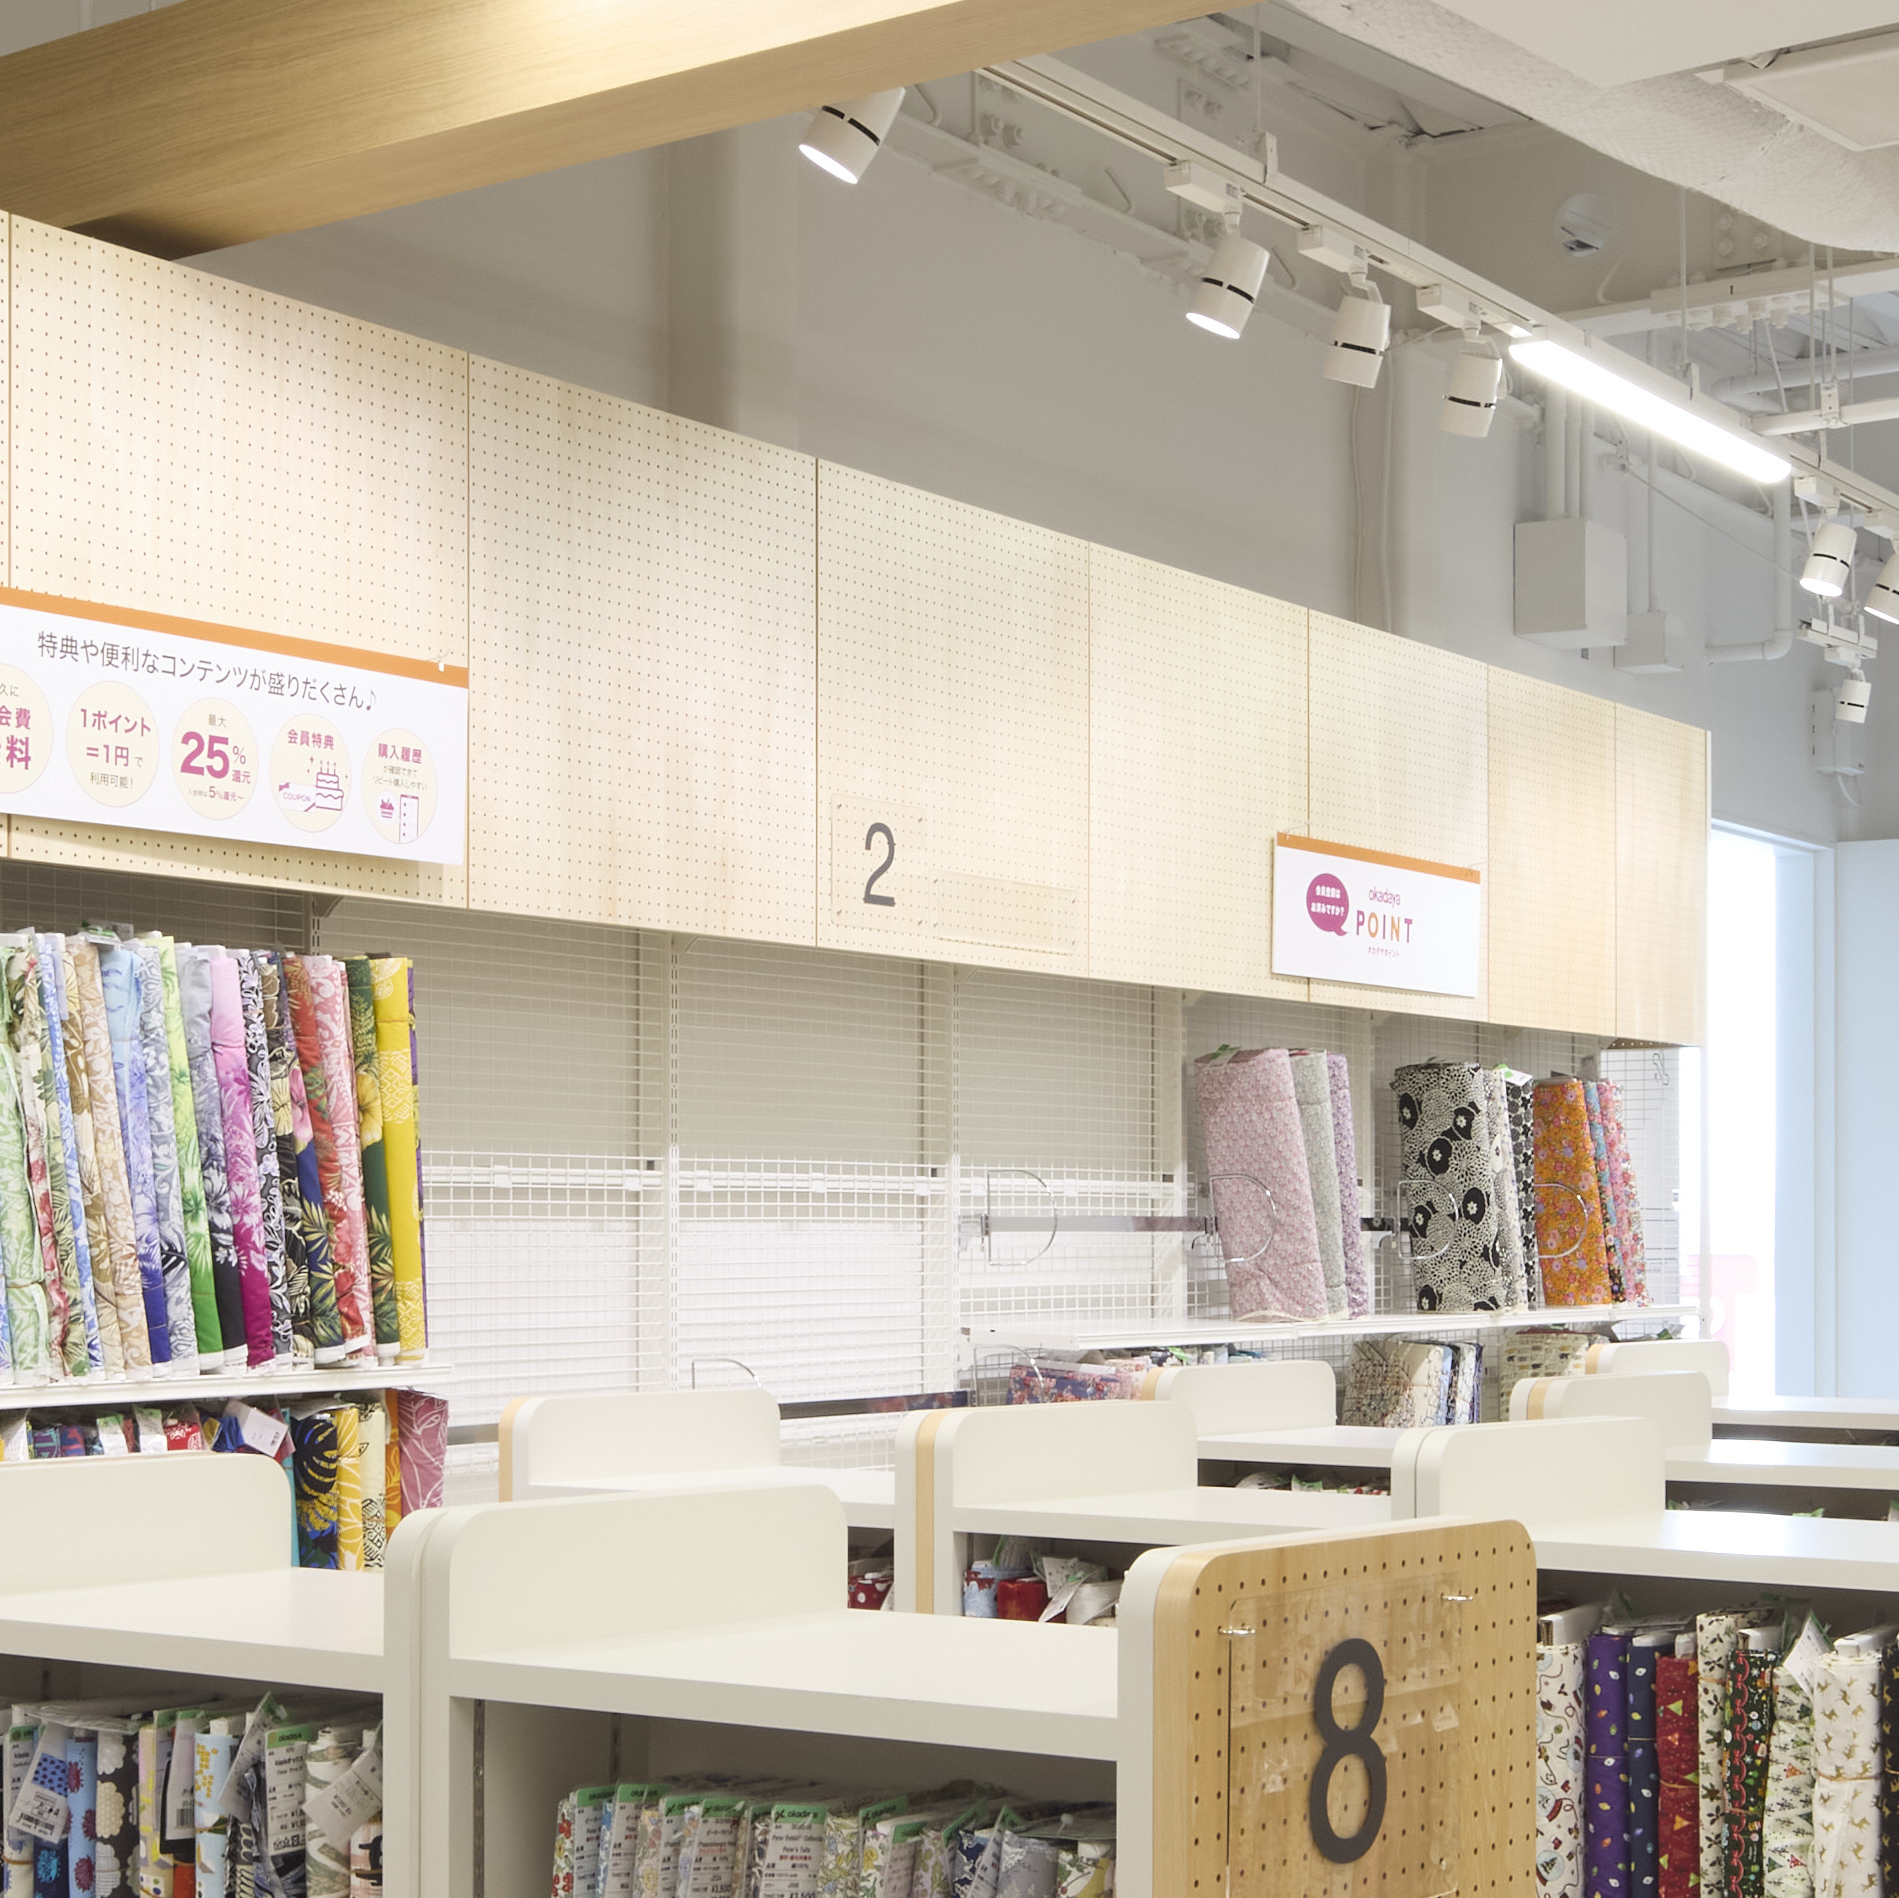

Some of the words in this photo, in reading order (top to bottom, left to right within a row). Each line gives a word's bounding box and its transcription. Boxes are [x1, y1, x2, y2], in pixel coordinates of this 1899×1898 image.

[81, 708, 151, 737] 1ポイント
[208, 714, 227, 728] 最大
[287, 728, 335, 751] 会員特典
[180, 731, 246, 779] 25%
[378, 743, 423, 764] 購入履歴
[282, 791, 312, 802] COUPON
[863, 822, 897, 907] 2
[1368, 886, 1401, 908] okadaya
[1356, 910, 1413, 943] POINT
[1309, 1638, 1388, 1864] 8
